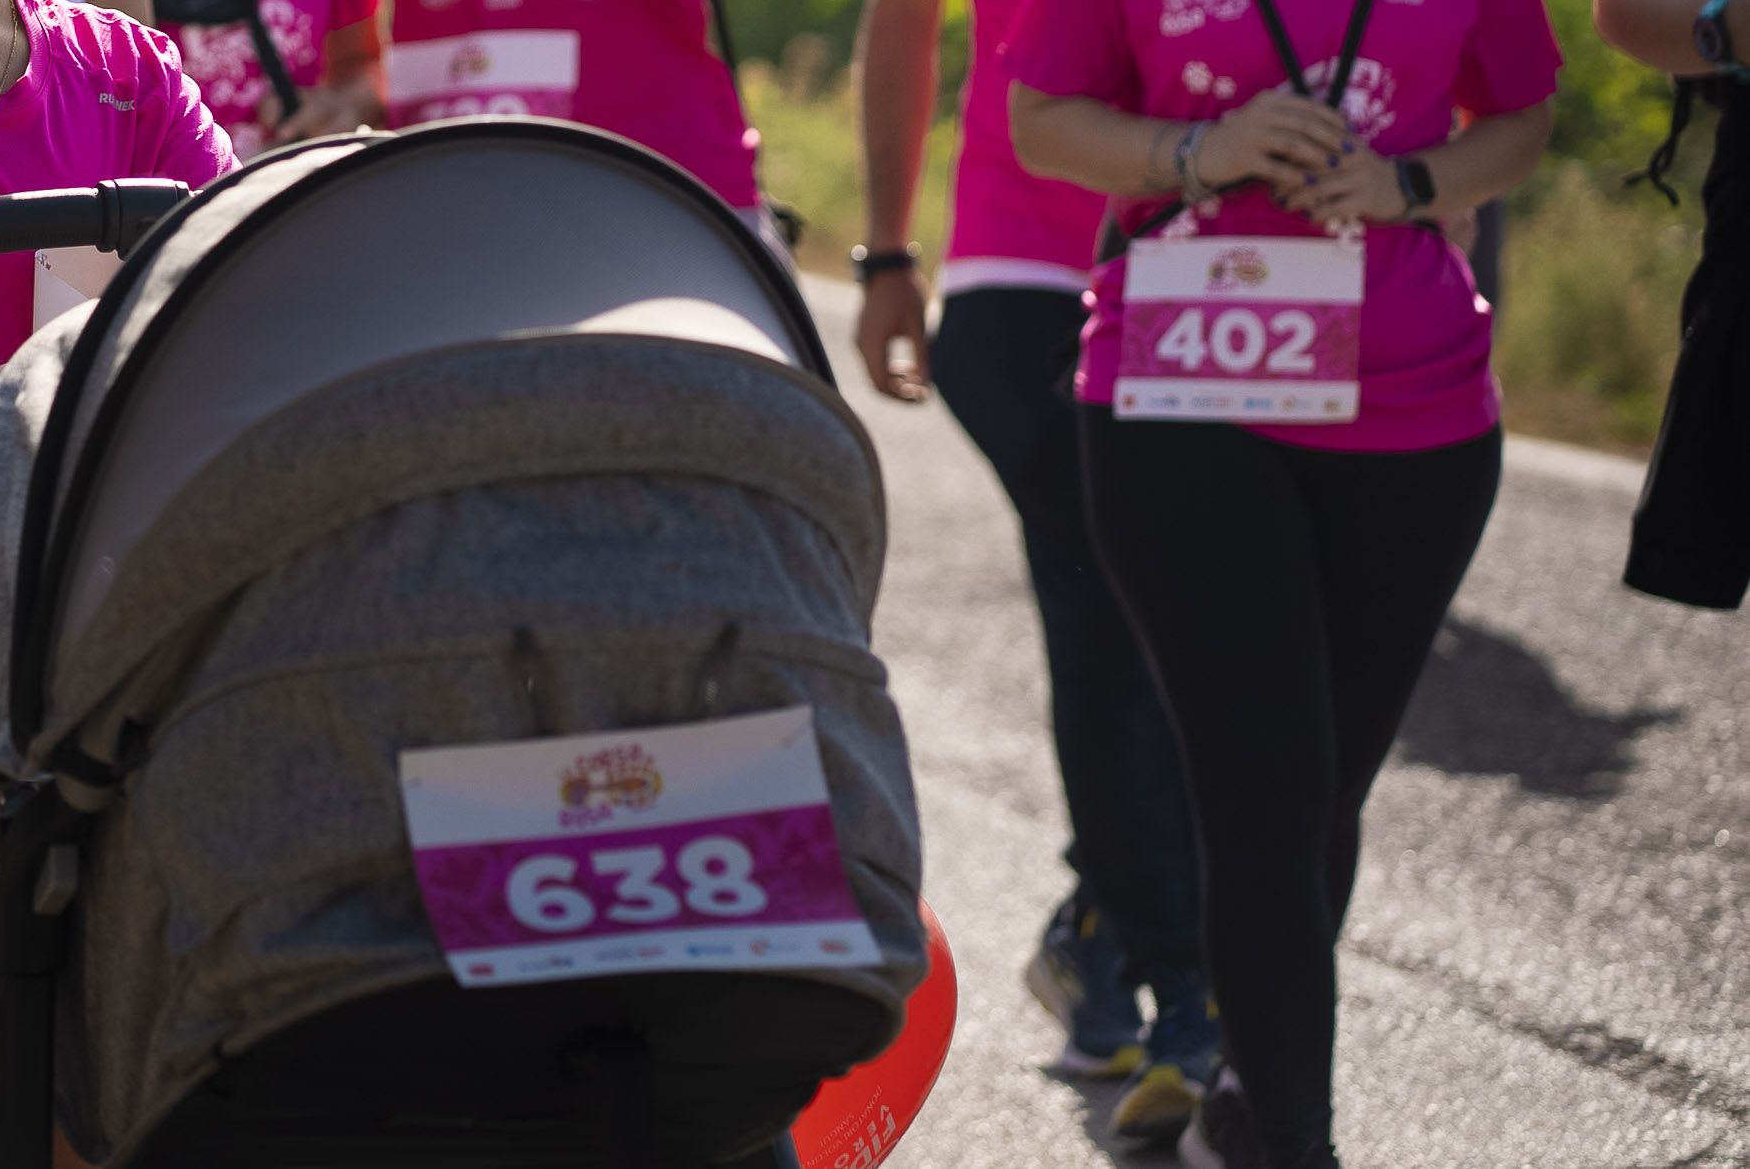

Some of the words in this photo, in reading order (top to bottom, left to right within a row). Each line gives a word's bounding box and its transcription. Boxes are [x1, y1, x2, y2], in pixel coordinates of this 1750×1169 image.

[1155, 307, 1316, 373] 402
[506, 836, 768, 932] 638
[823, 1104, 890, 1169] VERO
[847, 1112, 896, 1169] FID
